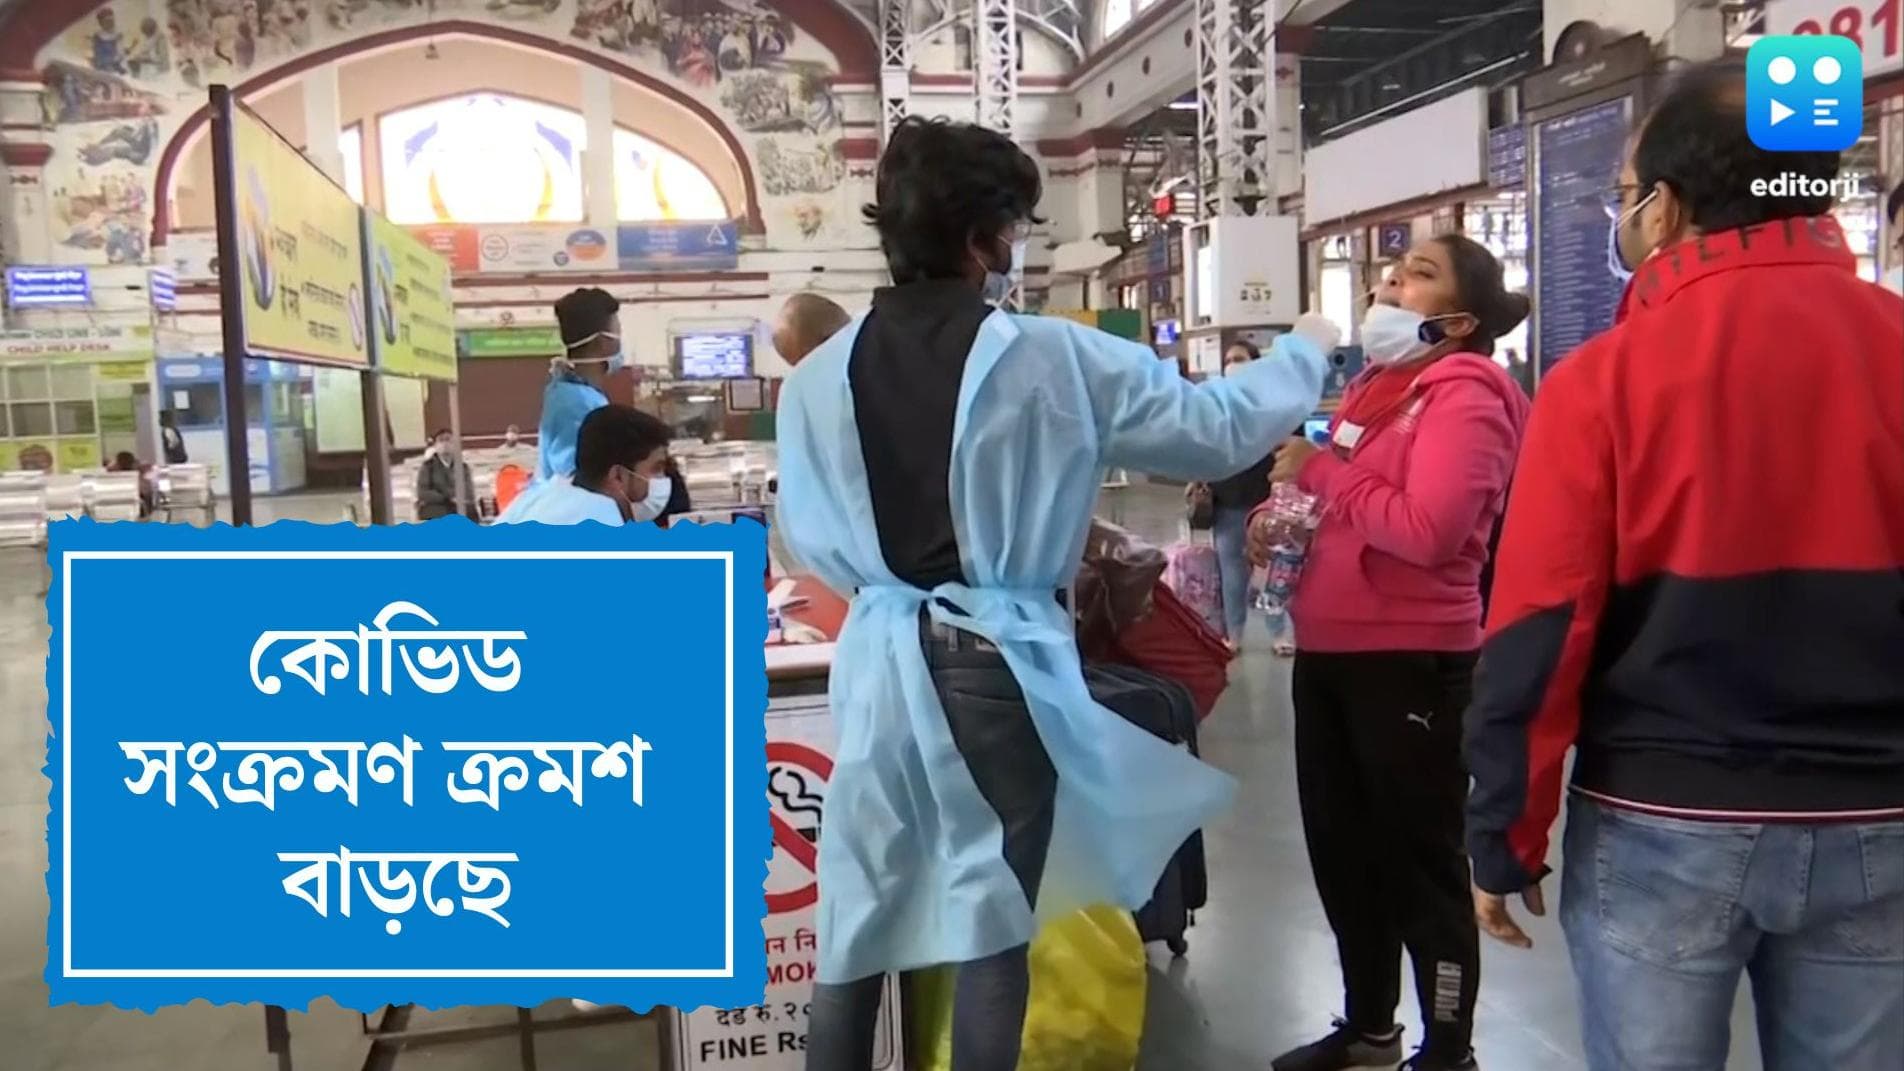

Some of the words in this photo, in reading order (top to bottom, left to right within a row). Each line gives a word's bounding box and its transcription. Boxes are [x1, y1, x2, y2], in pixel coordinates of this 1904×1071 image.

[1792, 0, 1901, 57] 81
[1389, 230, 1402, 248] 2
[7, 344, 43, 353] CHILD
[47, 343, 77, 353] HELP
[80, 342, 110, 352] DESK
[1434, 960, 1462, 1022] PUMA
[700, 1034, 768, 1063] FINE
